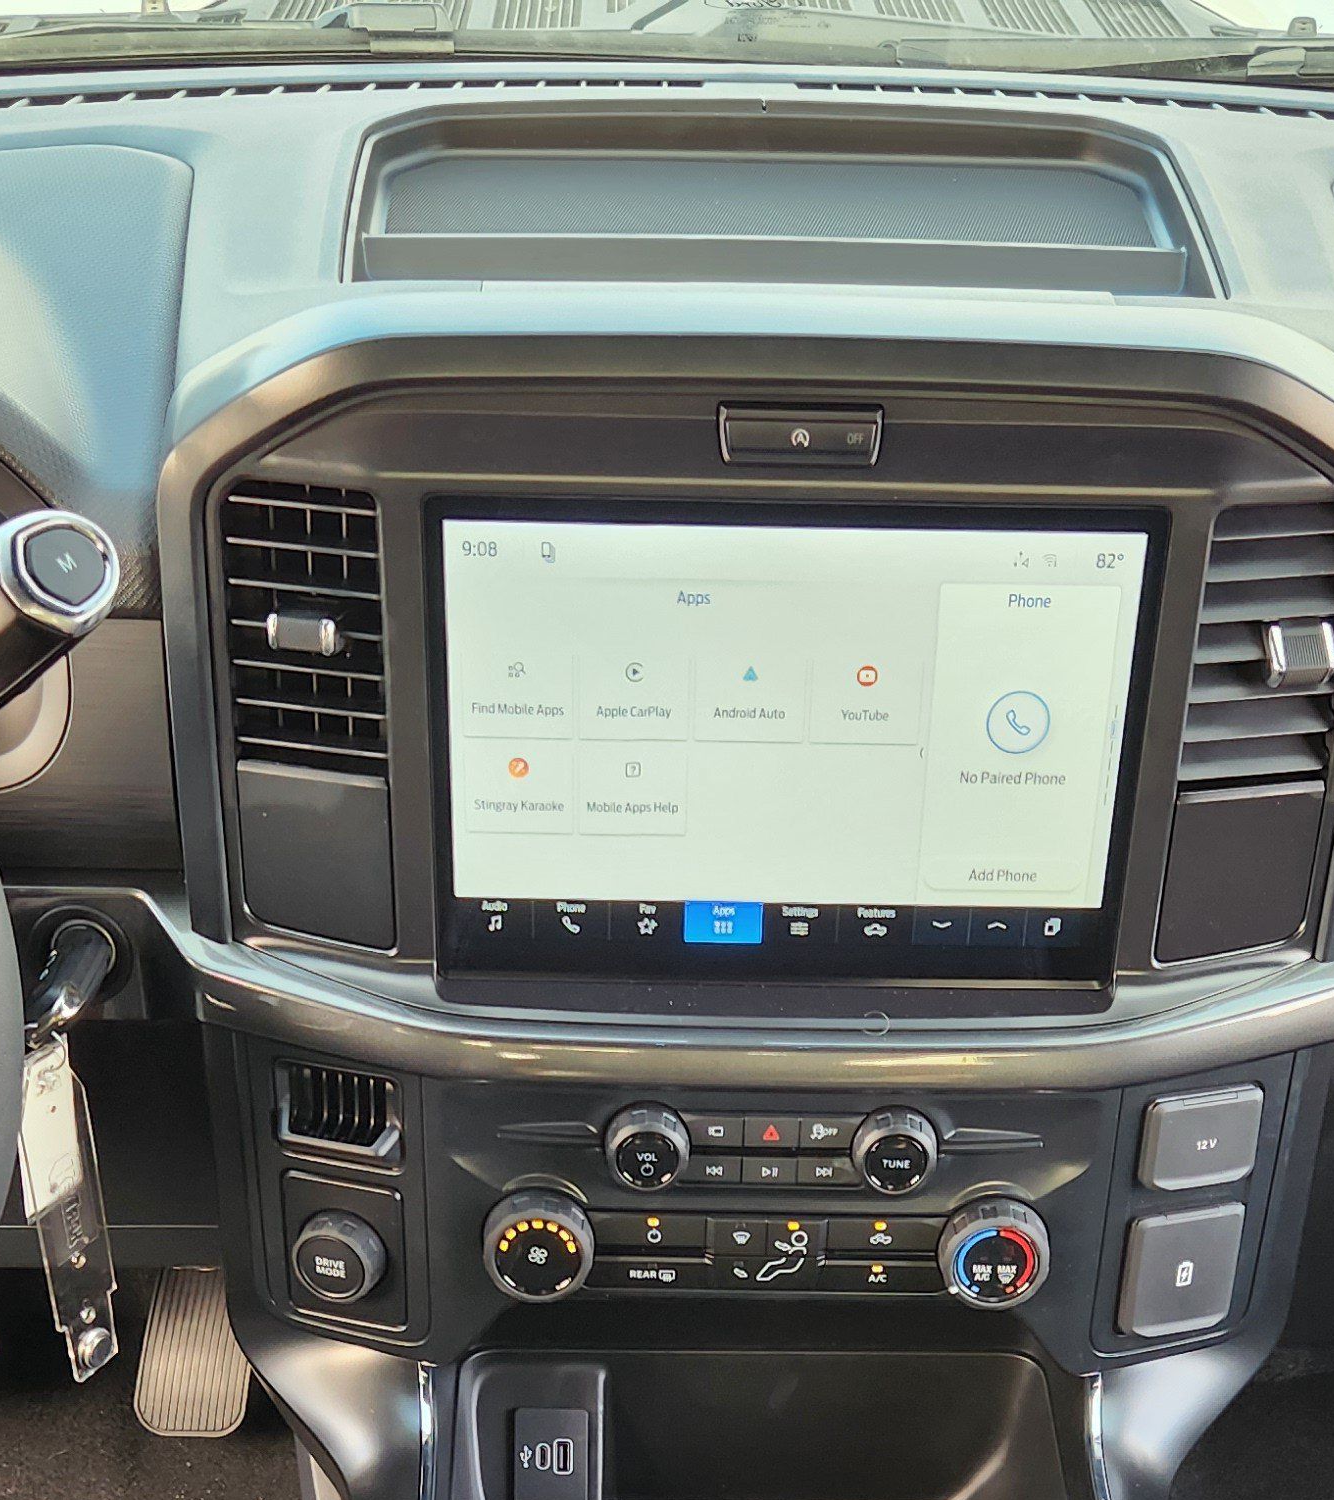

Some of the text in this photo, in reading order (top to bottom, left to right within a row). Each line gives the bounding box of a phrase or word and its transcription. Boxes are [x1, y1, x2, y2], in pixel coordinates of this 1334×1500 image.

[846, 432, 865, 446] OFF
[461, 541, 498, 557] 9:08
[54, 551, 78, 574] M
[676, 590, 711, 607] Apps
[1007, 593, 1052, 608] Phone
[471, 702, 565, 717] Find Mobile Apps
[596, 706, 672, 719] Apple CarPlay
[713, 707, 786, 720] Android Auto
[841, 709, 890, 721] YouTube
[959, 770, 1067, 786] No Paired Phone
[474, 799, 565, 813] Stingray Karaoke
[586, 802, 679, 815] Mobile Apps Help
[968, 868, 1038, 883] Add Phone
[712, 904, 736, 917] Apps
[781, 906, 820, 919] Settings
[857, 907, 897, 919] Features
[636, 1152, 659, 1163] VOL
[881, 1158, 912, 1170] TUNE
[314, 1255, 346, 1271] DRIVE
[972, 1264, 993, 1275] MAX
[996, 1264, 1018, 1275] MAX
[315, 1265, 347, 1279] MODE
[629, 1269, 657, 1280] REAR
[868, 1273, 889, 1283] A/C
[973, 1272, 992, 1282] A/C
